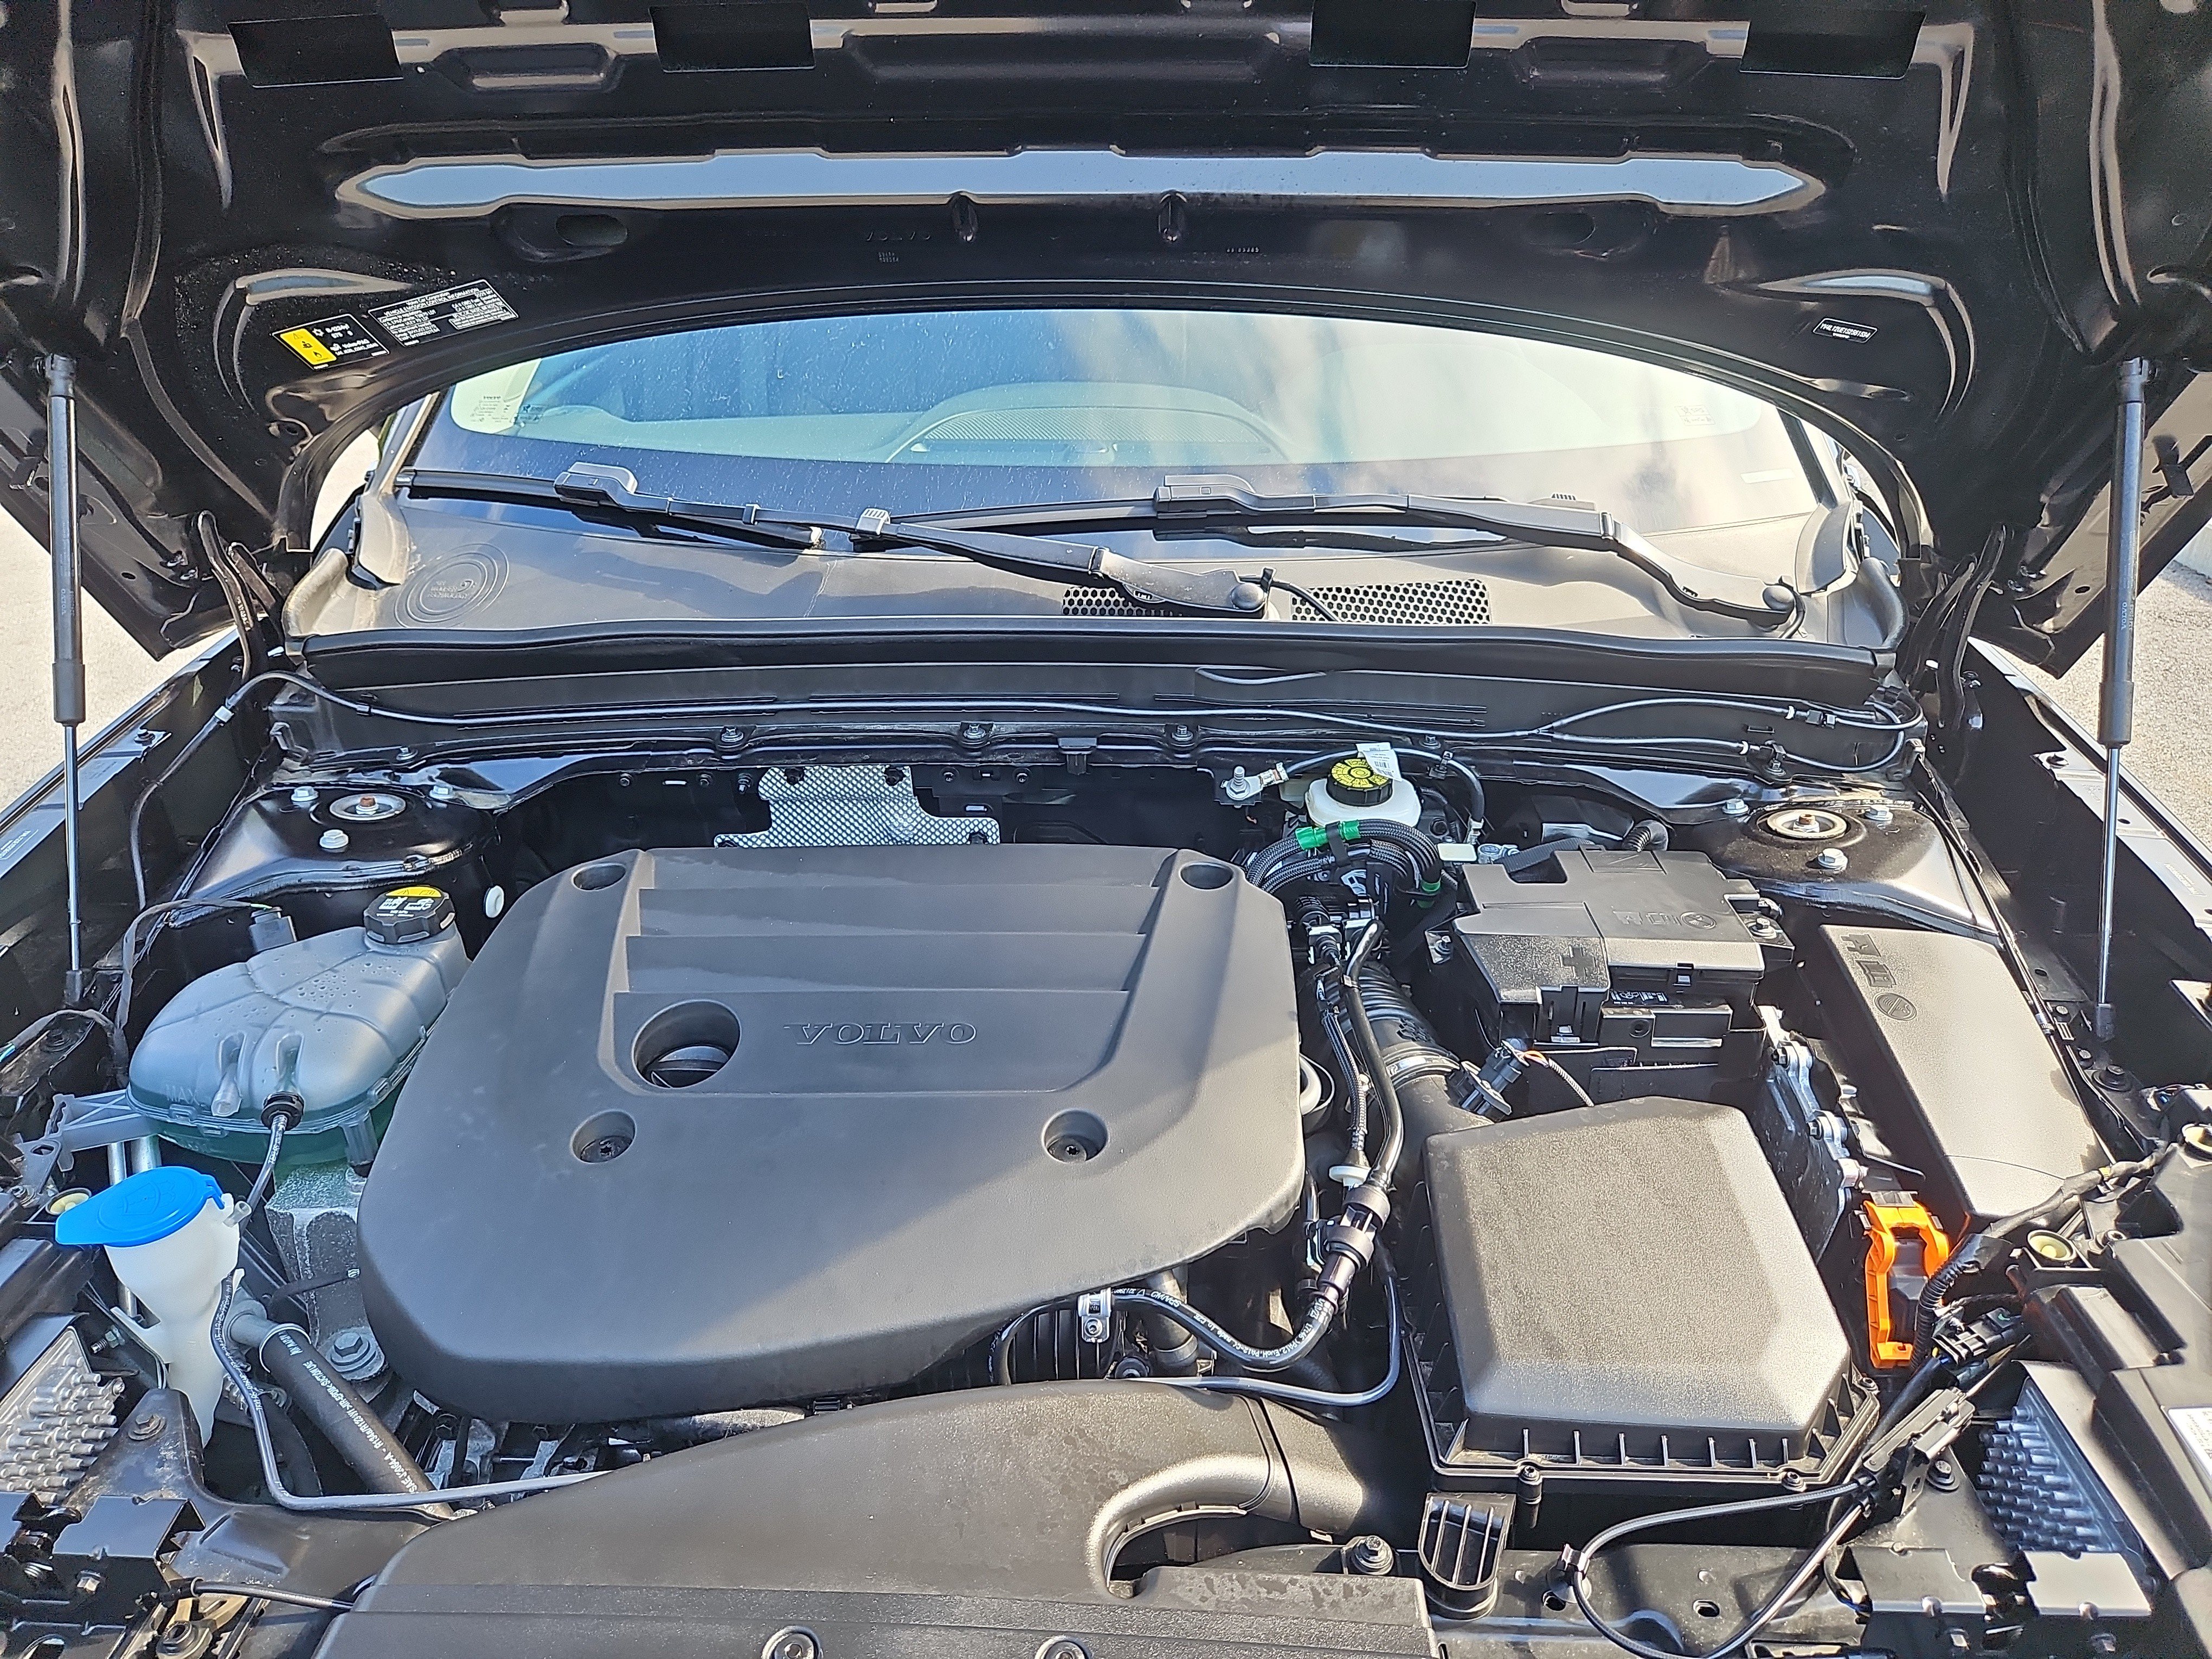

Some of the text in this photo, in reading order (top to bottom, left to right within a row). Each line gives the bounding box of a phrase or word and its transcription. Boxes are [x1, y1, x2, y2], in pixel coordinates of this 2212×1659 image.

[783, 1022, 977, 1044] VOLVO
[166, 1084, 200, 1106] MAX
[1215, 1329, 1232, 1345] made
